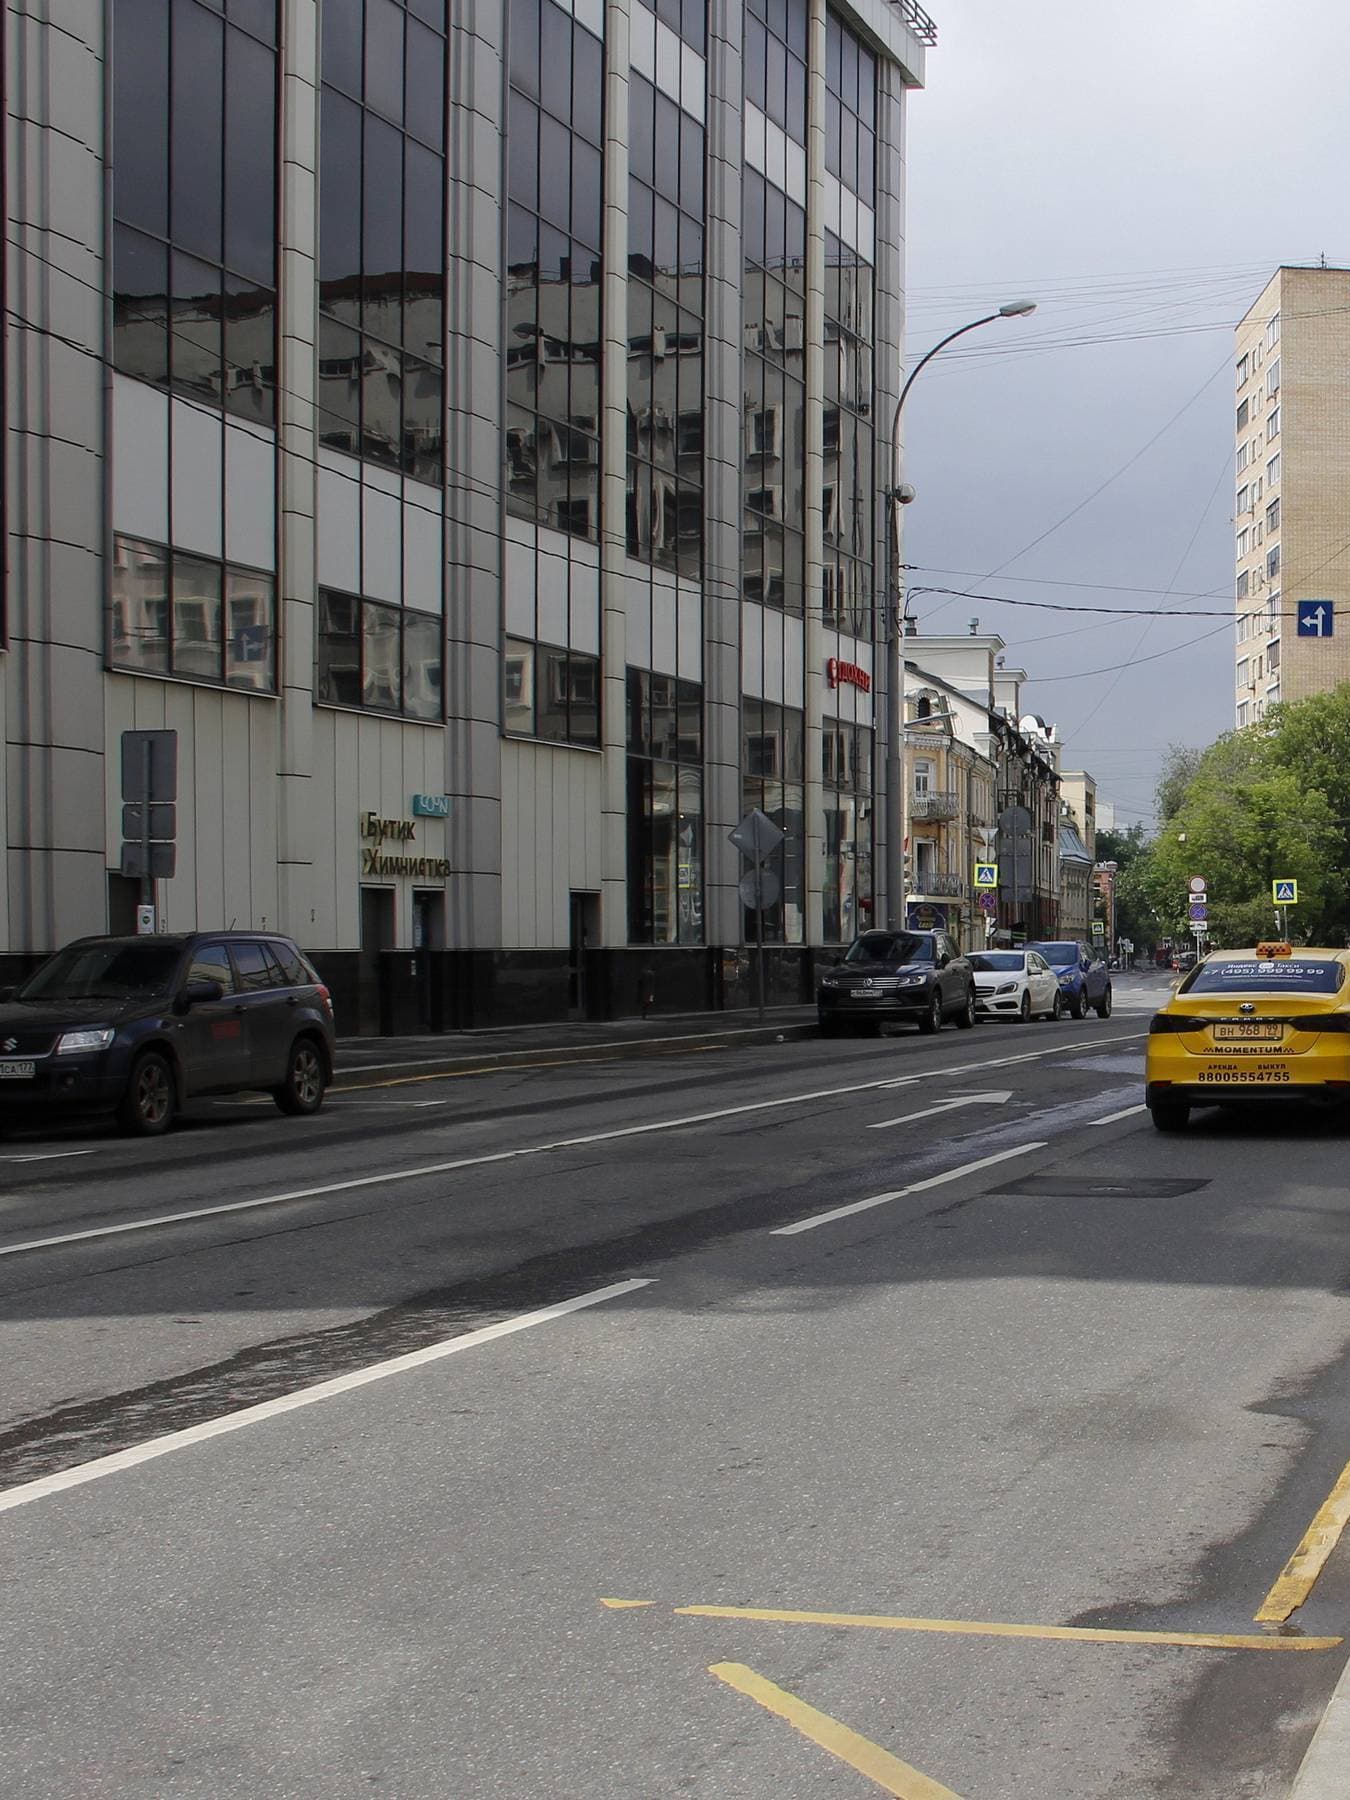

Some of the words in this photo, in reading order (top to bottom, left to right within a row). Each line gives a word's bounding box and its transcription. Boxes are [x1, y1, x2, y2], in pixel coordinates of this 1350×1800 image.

[361, 811, 416, 846] Бутик
[1239, 1024, 1260, 1036] 968
[1198, 1072, 1290, 1082] 88005554755
